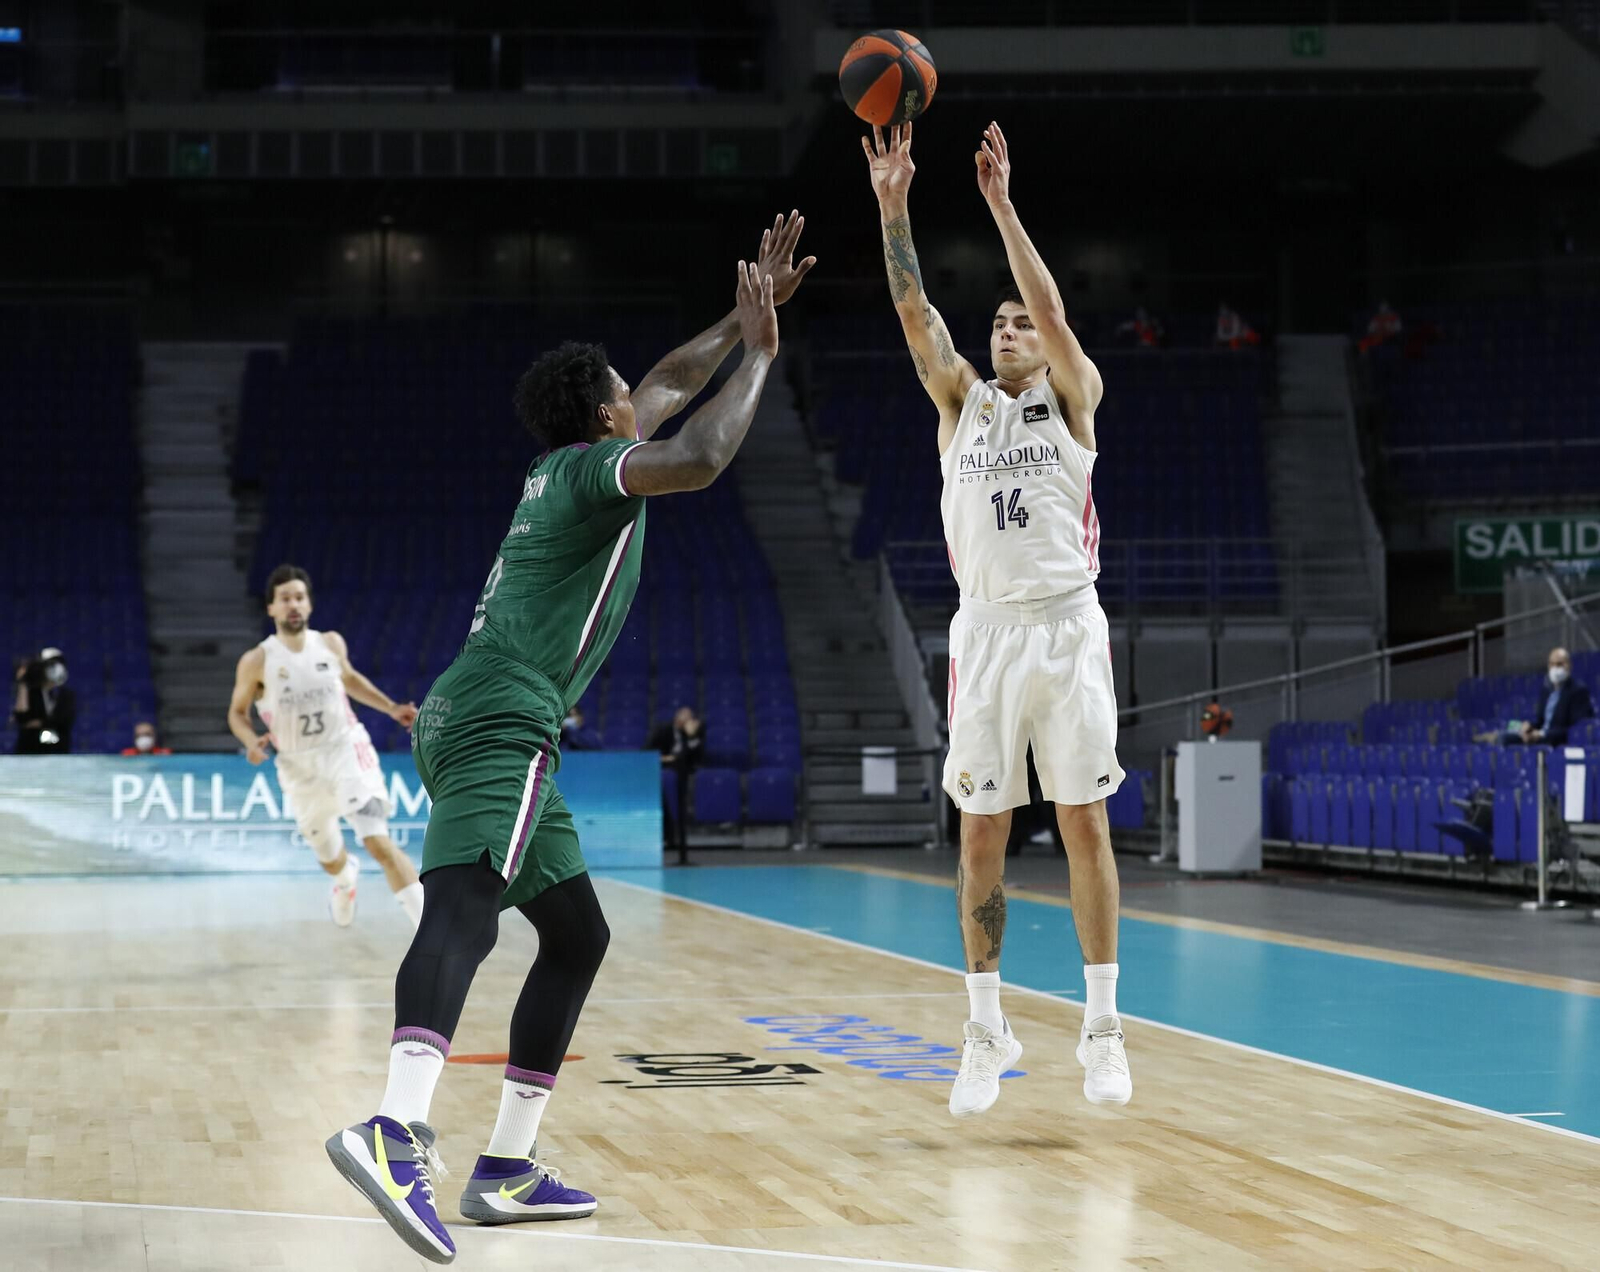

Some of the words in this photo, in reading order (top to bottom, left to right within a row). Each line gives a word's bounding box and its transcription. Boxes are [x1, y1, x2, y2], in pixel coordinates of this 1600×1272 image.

[1025, 413, 1048, 421] endesa
[960, 445, 1060, 470] PALLADIUM
[960, 473, 1000, 484] HOTEL
[1012, 468, 1062, 479] GROUP
[991, 488, 1029, 530] 14
[298, 711, 325, 736] 23
[112, 772, 430, 820] PALLAM
[598, 1052, 823, 1089] liga
